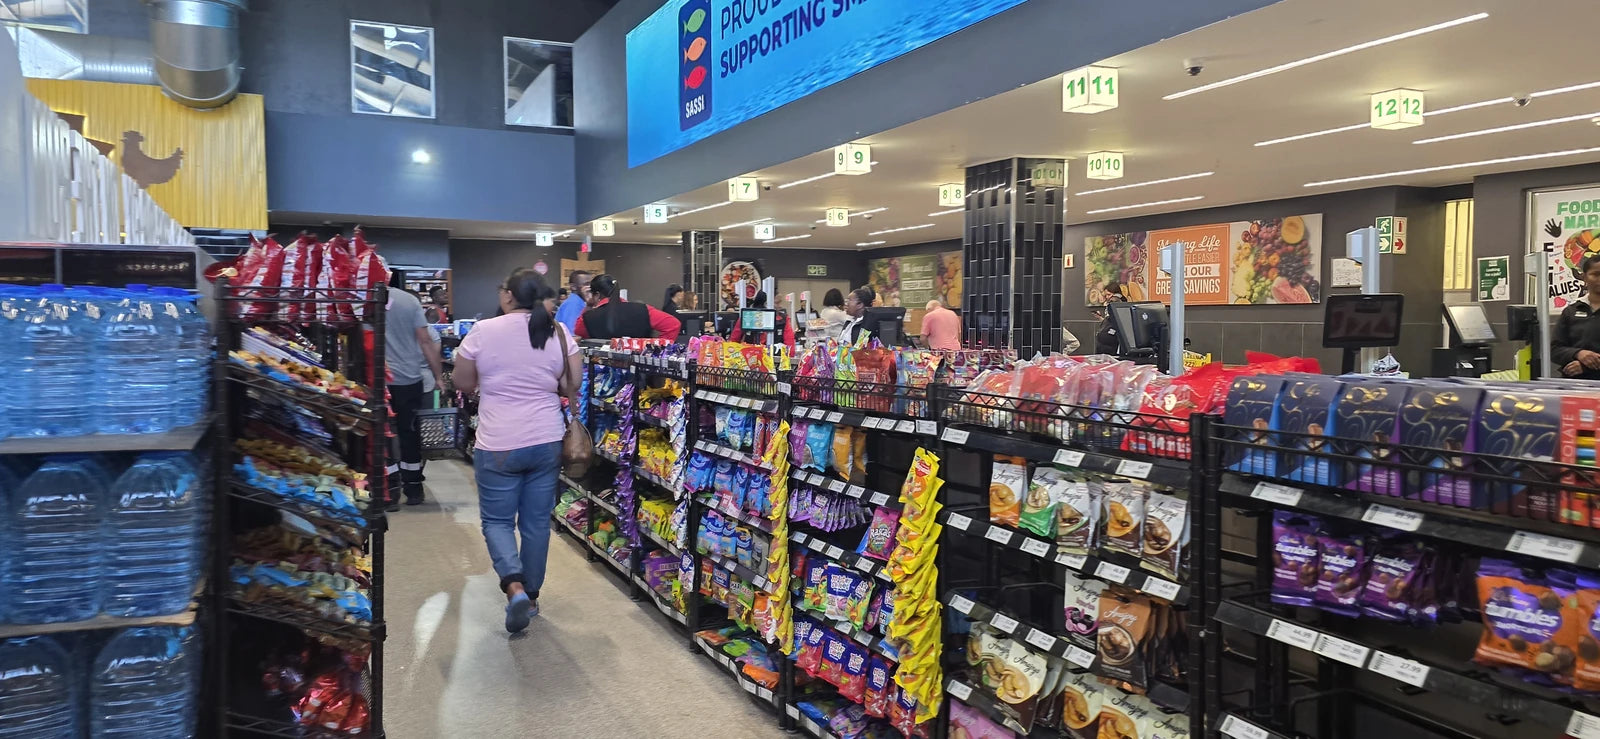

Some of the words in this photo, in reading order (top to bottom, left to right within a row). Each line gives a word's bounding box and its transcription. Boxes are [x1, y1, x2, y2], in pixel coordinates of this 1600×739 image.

[720, 0, 782, 41] PRO
[720, 0, 825, 78] SUPPORTING
[1067, 76, 1085, 98] 11
[1092, 75, 1114, 95] 11
[685, 94, 705, 119] SASSI
[1374, 98, 1397, 117] 12
[1402, 97, 1420, 115] 12
[838, 152, 844, 166] 9
[854, 151, 864, 165] 9
[1089, 158, 1102, 171] 10
[1105, 158, 1121, 171] 10
[742, 182, 751, 194] 7
[942, 189, 948, 200] 8
[955, 188, 962, 200] 8
[655, 208, 662, 218] 5
[837, 211, 844, 222] 6
[602, 223, 608, 232] 3
[763, 227, 769, 236] 4
[1198, 235, 1221, 252] Life
[1190, 265, 1212, 277] OUR
[1155, 280, 1171, 295] GRE
[1184, 278, 1220, 294] SAVINGS
[1548, 280, 1580, 299] ALUES
[1275, 542, 1318, 557] tumbles
[1485, 601, 1560, 627] tumbles
